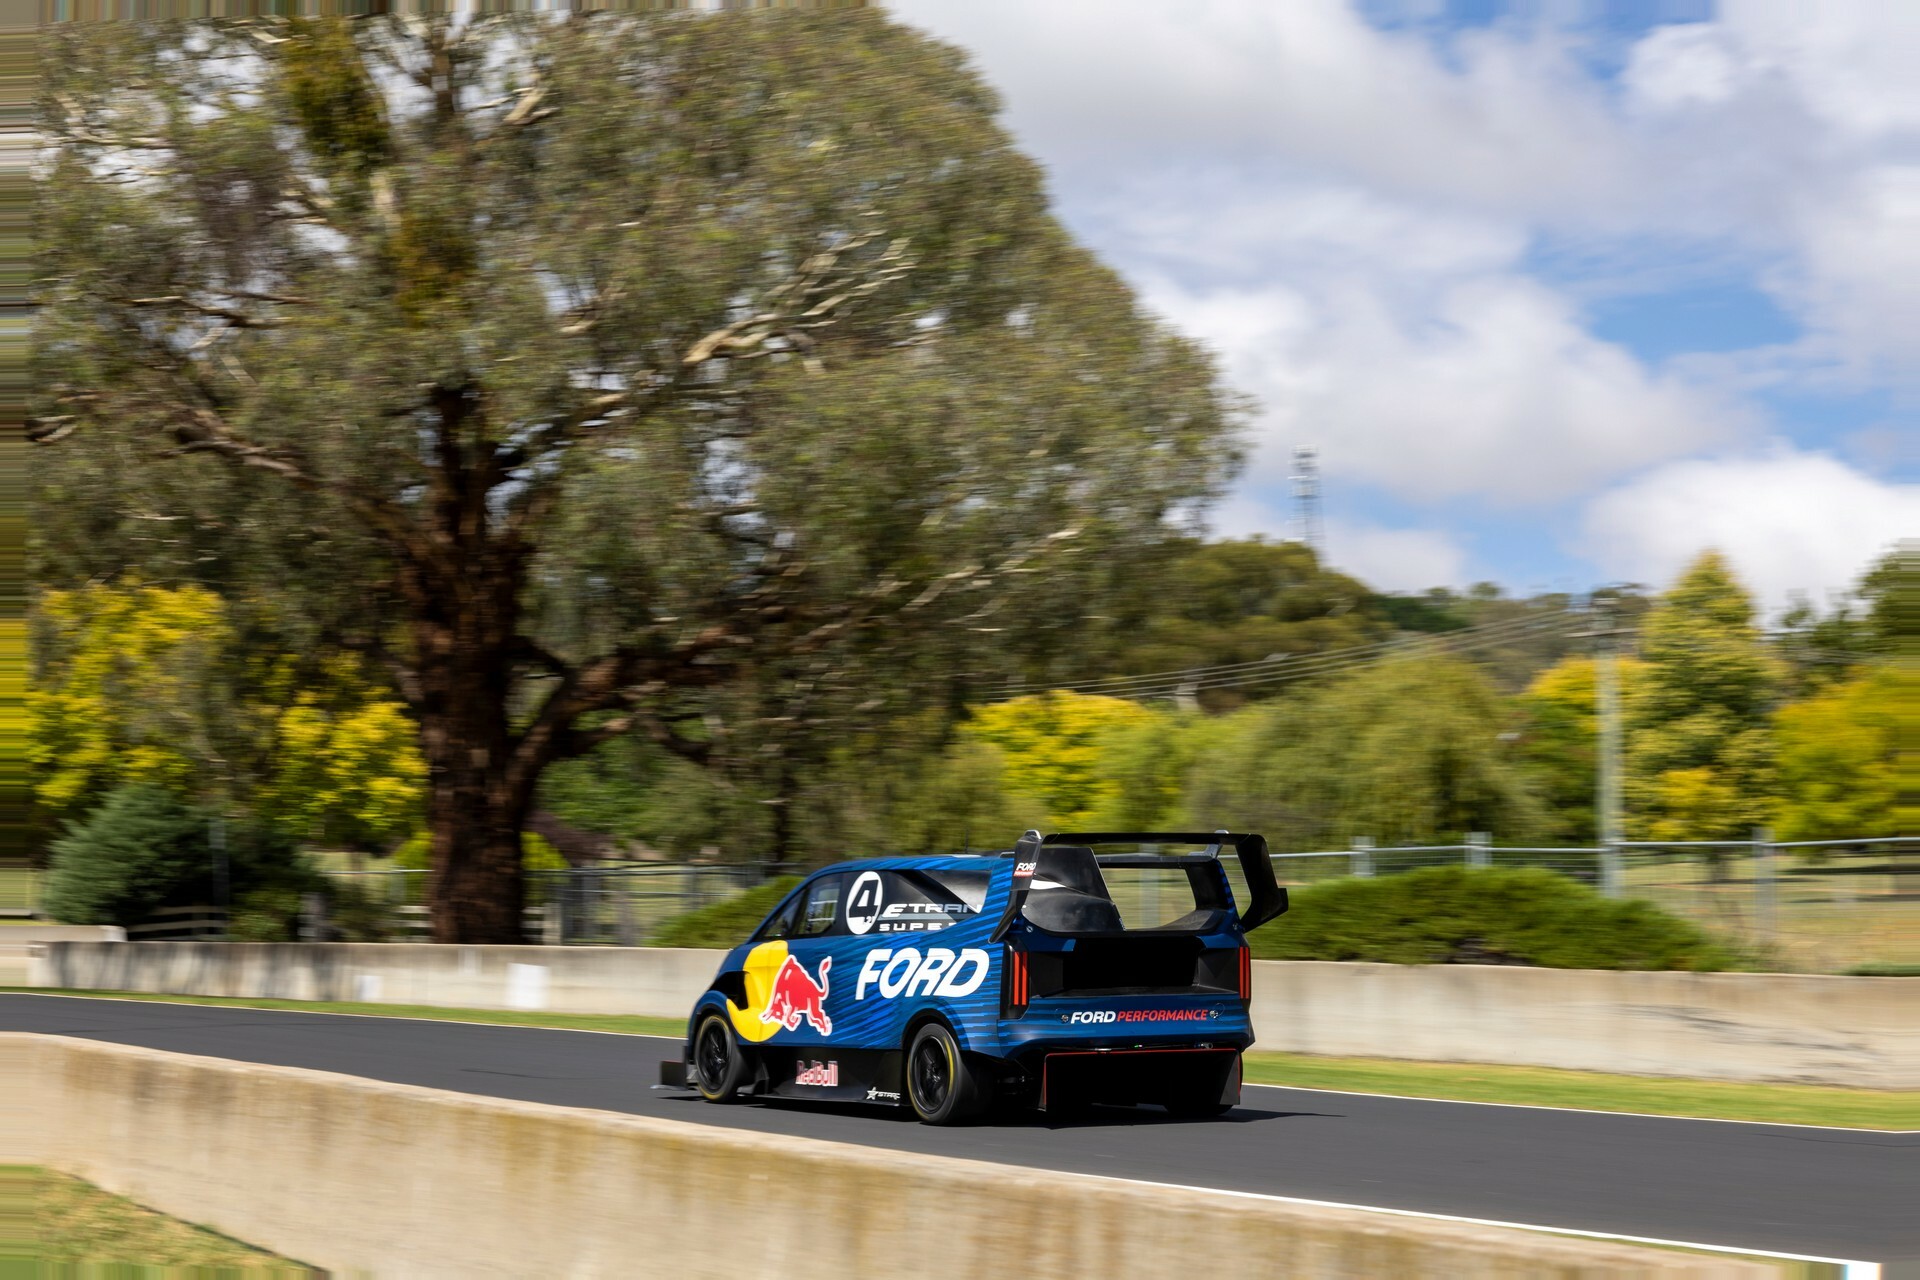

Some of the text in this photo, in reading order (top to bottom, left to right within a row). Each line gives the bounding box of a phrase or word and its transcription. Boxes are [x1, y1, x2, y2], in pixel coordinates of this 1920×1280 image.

[879, 922, 957, 932] SUPE
[855, 947, 990, 1000] FORD
[1070, 1009, 1209, 1024] FORD PERFORMANCE
